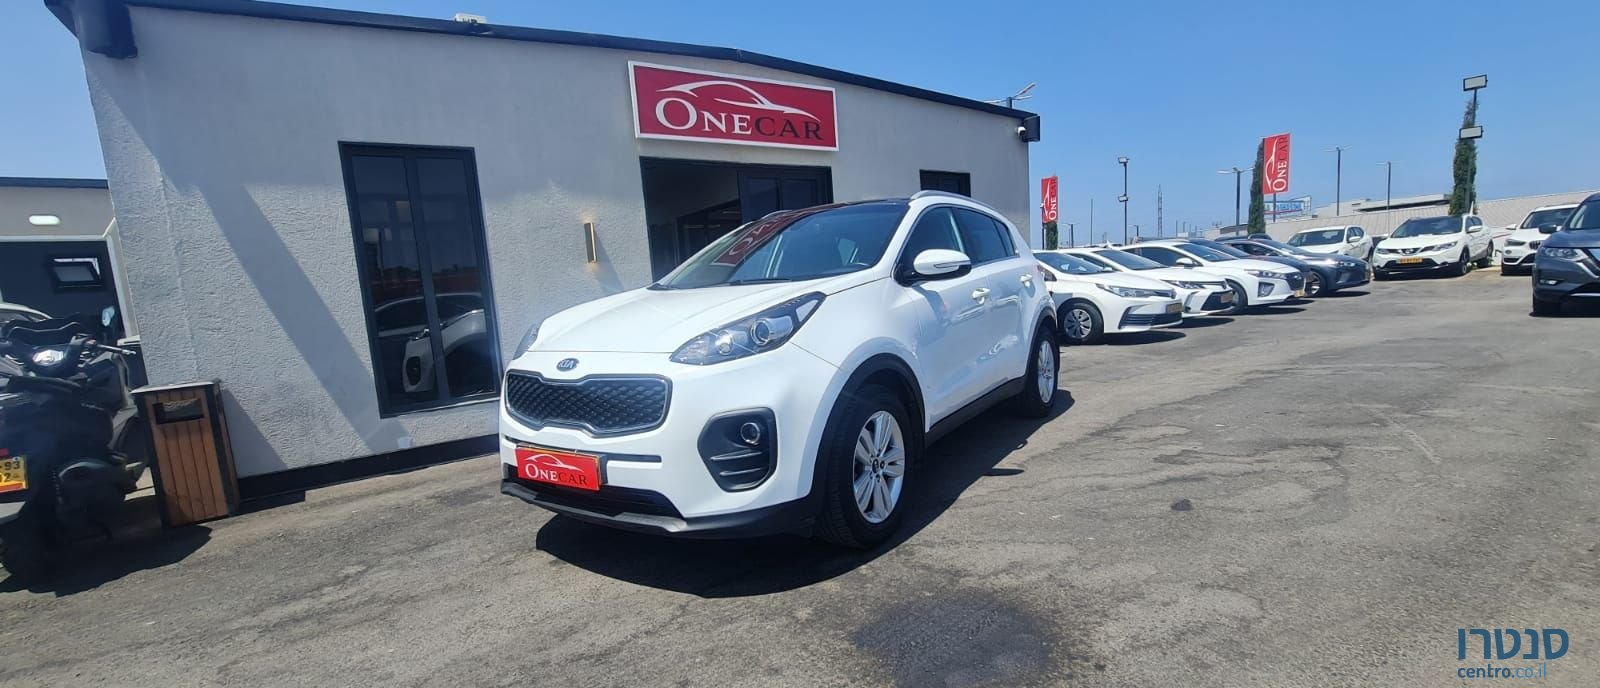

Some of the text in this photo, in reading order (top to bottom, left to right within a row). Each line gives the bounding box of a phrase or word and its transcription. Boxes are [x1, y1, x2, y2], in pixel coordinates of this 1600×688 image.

[655, 97, 822, 141] ONECAR
[558, 359, 577, 369] KIA
[525, 463, 587, 485] ONECAR
